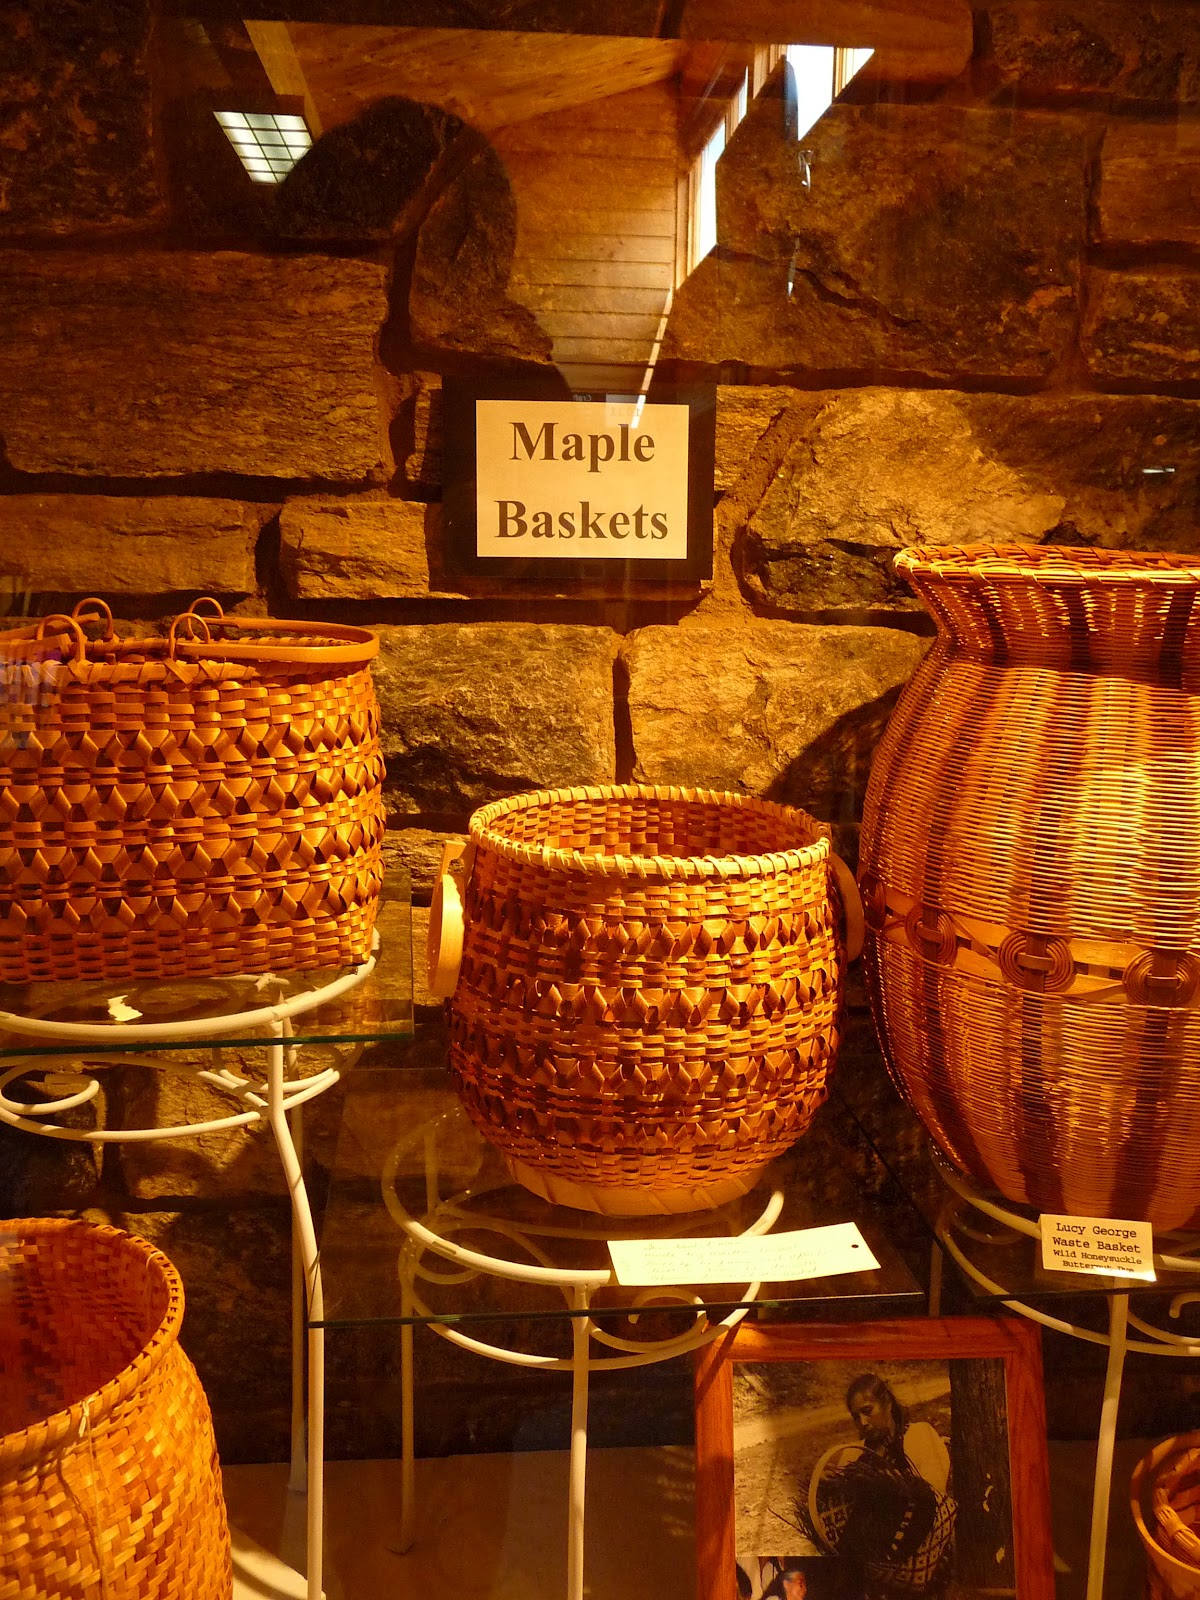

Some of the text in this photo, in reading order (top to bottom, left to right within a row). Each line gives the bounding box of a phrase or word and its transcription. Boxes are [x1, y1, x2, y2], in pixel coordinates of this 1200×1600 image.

[509, 422, 655, 473] Maple
[494, 501, 668, 540] Baskets
[1056, 1223, 1137, 1239] Lucy George
[1052, 1237, 1141, 1253] Waste Basket
[1053, 1250, 1142, 1264] Wild Honeysuckle
